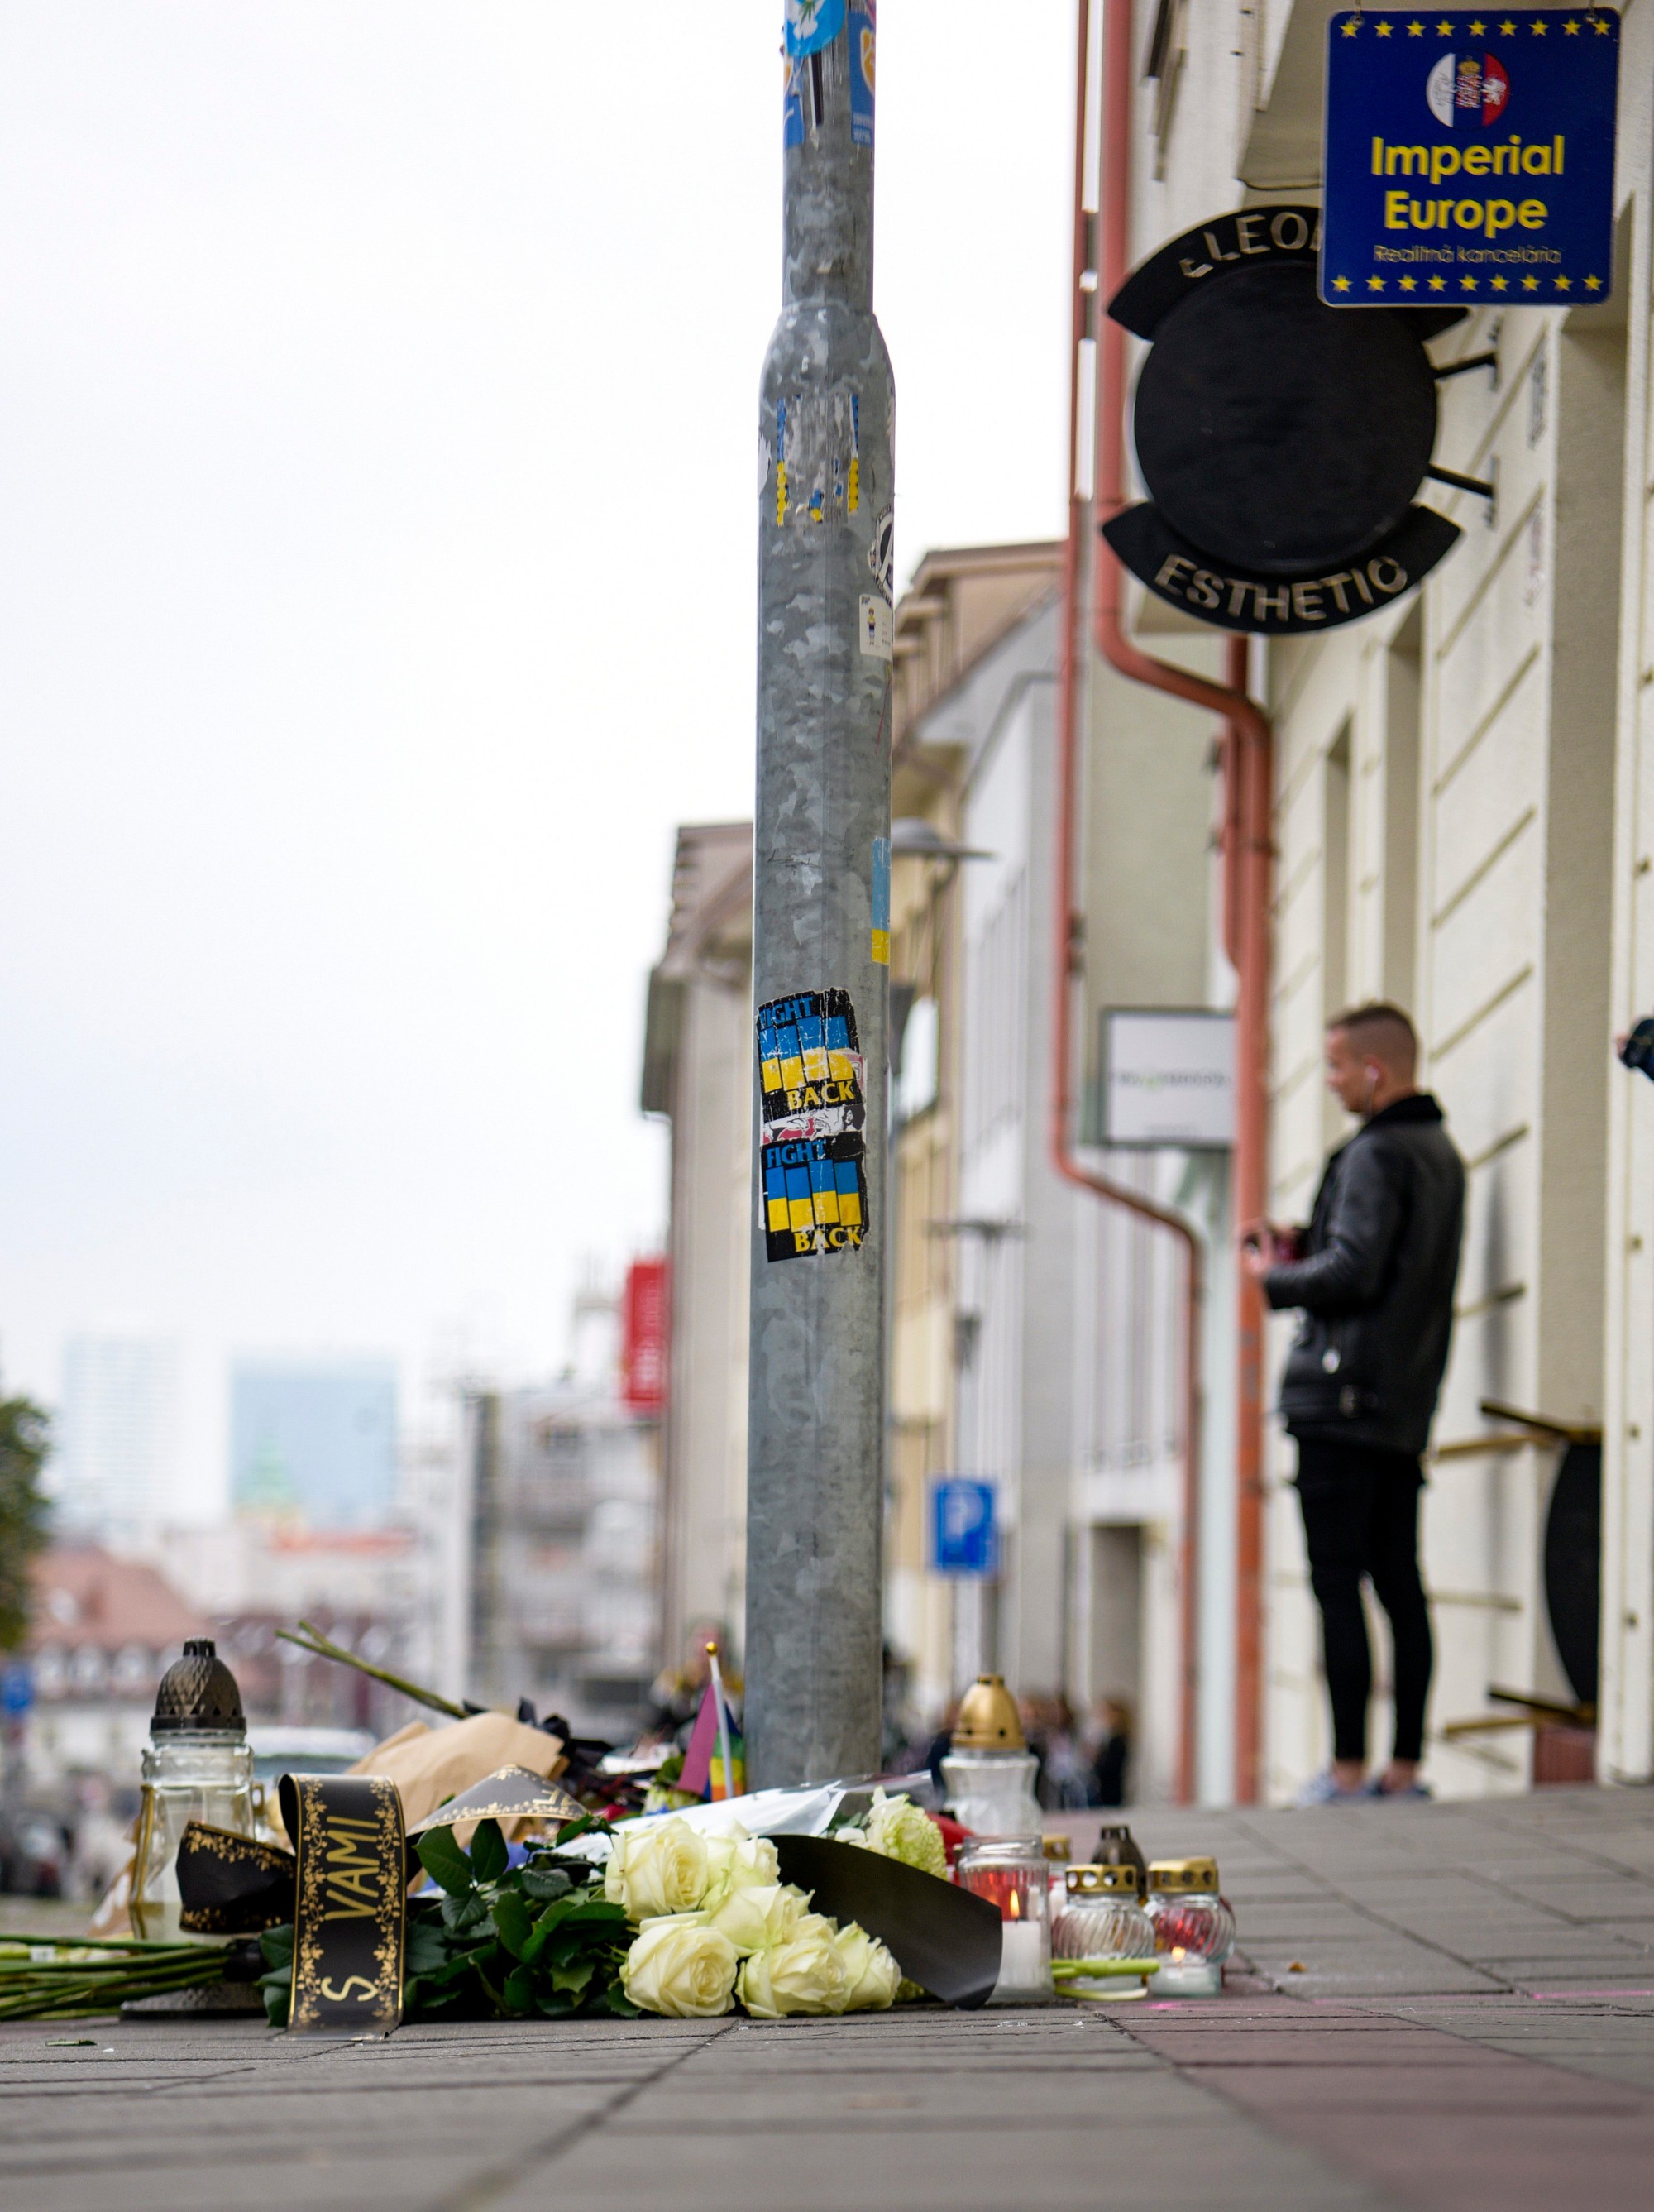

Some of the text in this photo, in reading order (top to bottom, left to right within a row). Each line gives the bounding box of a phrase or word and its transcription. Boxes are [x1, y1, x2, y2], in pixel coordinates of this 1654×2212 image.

[1370, 134, 1565, 185] Imperial
[1384, 190, 1549, 239] Europe
[786, 1080, 855, 1111] BACK
[766, 1139, 826, 1168] FIGHT
[794, 1225, 862, 1252] BACK
[323, 1815, 380, 1922] VAMI
